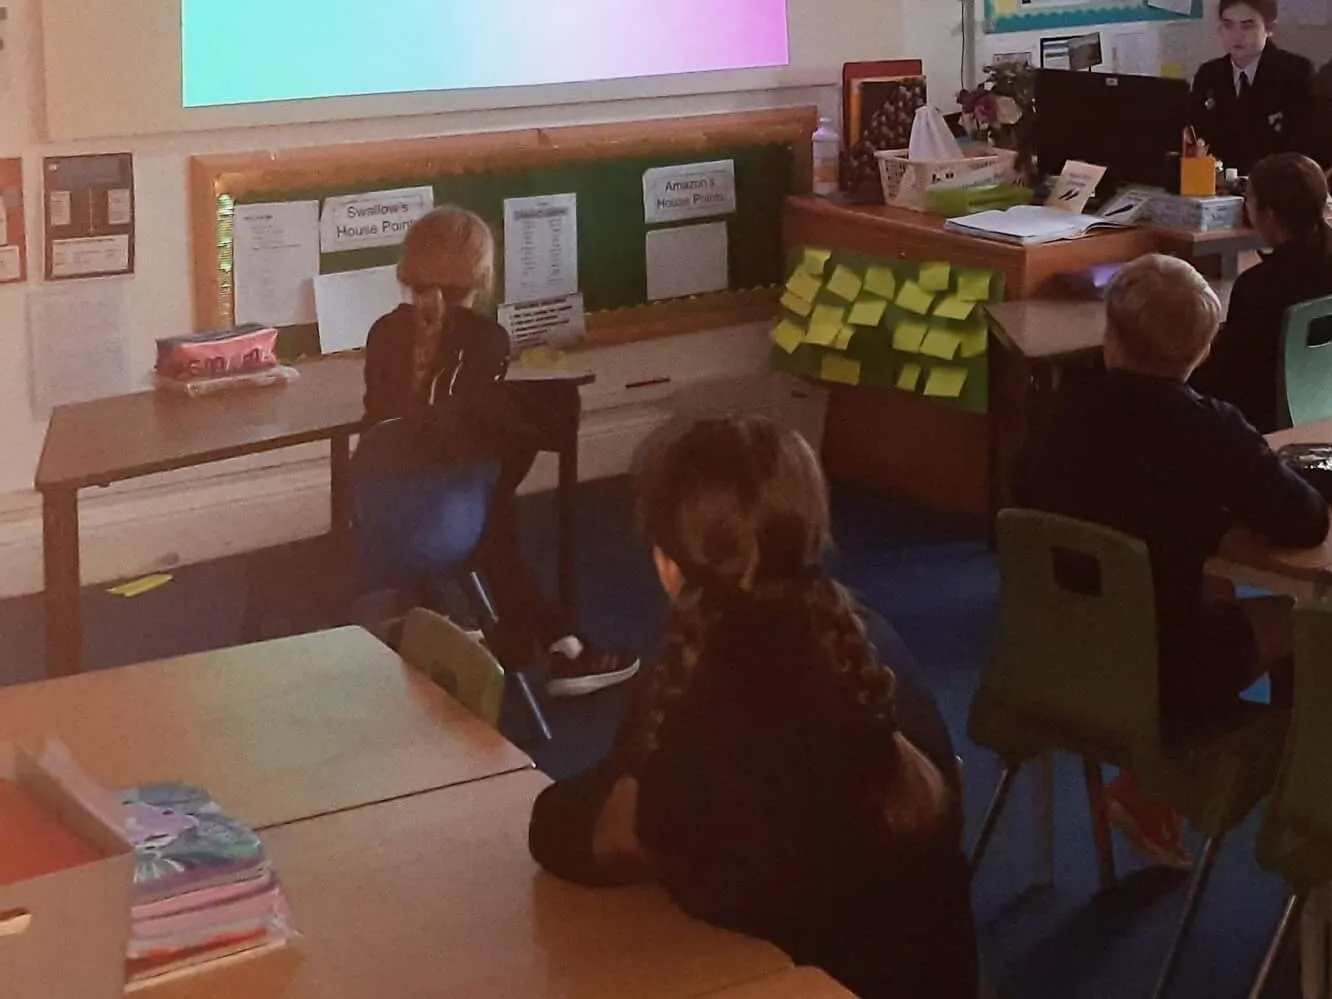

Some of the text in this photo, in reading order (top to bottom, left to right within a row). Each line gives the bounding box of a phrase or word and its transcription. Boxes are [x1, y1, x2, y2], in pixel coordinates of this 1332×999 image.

[664, 177, 717, 192] Amazon's
[346, 200, 410, 219] Swallow's
[656, 191, 726, 210] House Points
[335, 218, 414, 240] House Poin
